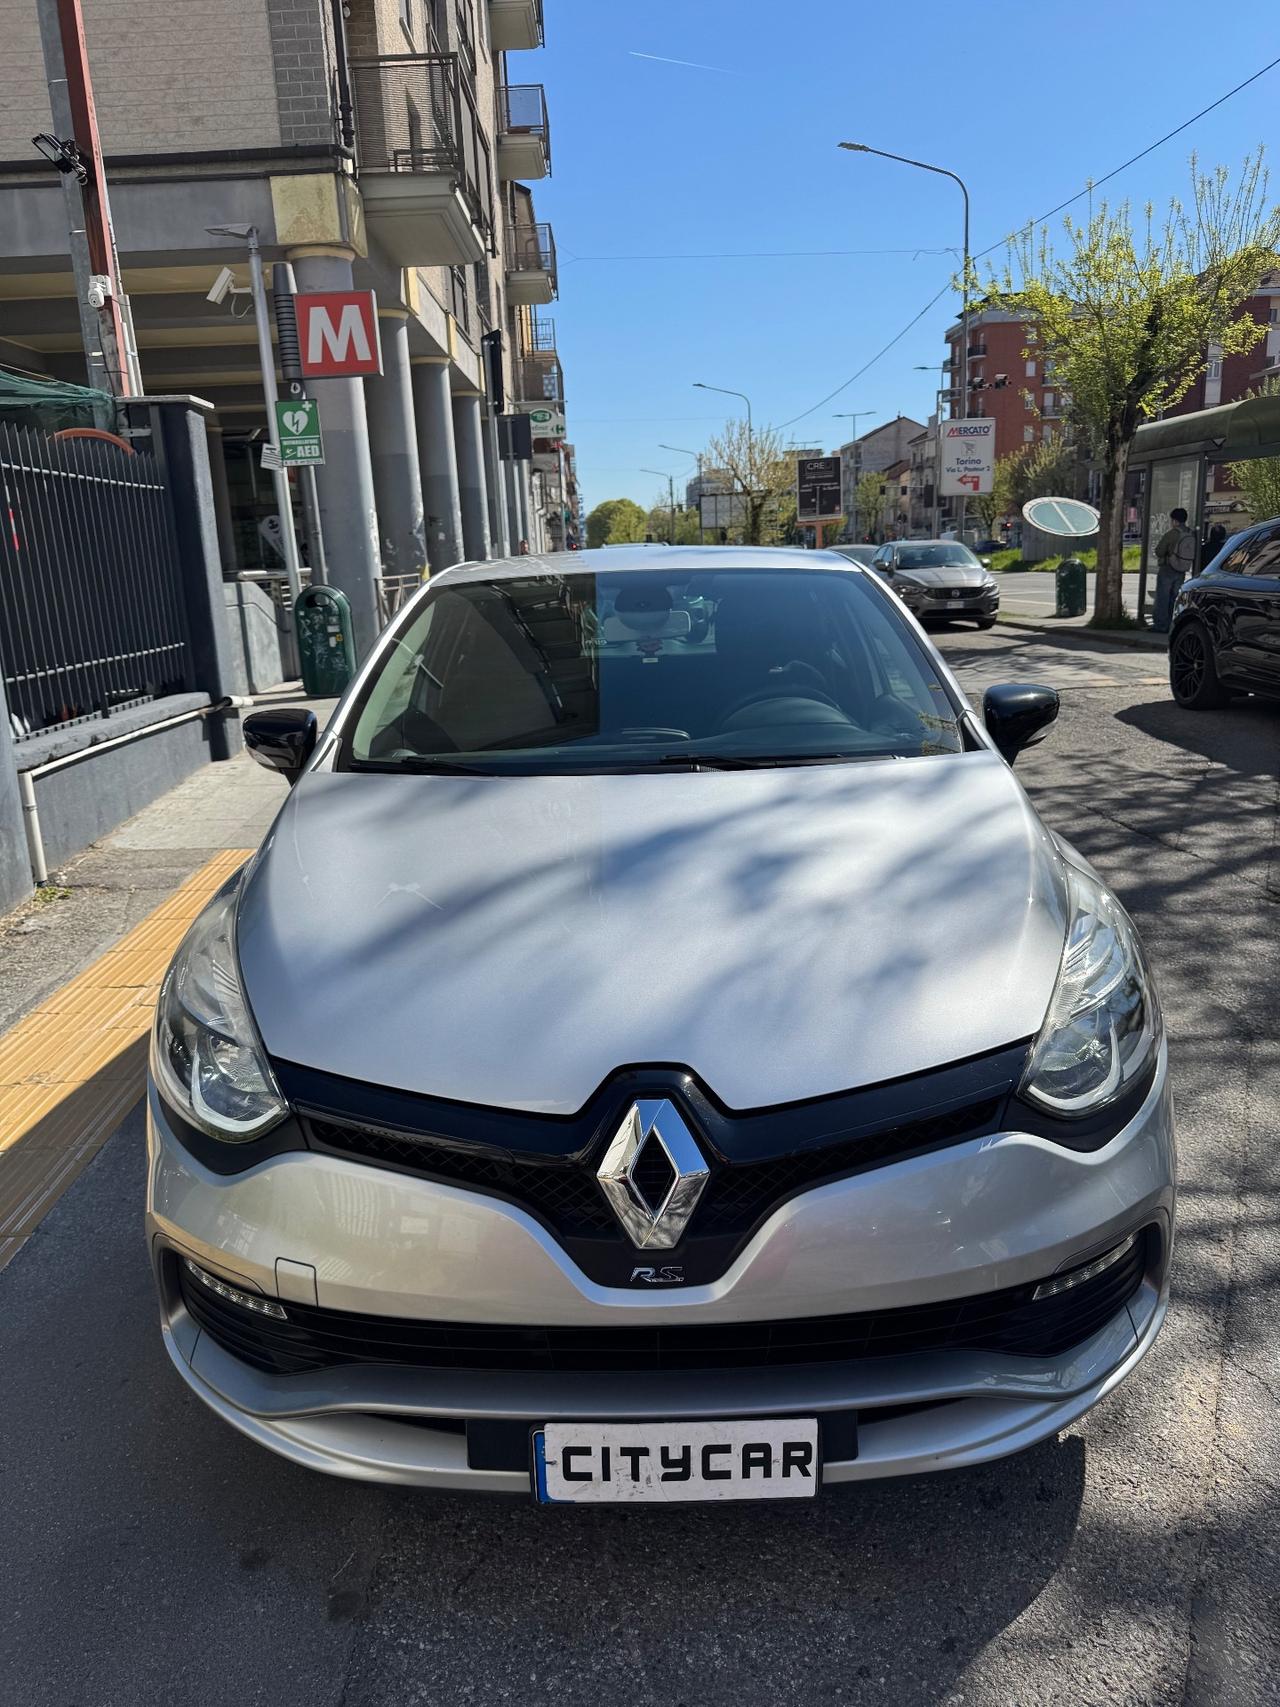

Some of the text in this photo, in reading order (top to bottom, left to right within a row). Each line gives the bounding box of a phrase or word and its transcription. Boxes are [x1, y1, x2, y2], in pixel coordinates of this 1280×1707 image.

[308, 305, 372, 364] M
[947, 426, 991, 437] MERCATO
[297, 445, 320, 457] AED
[956, 457, 982, 465] Torino
[562, 1441, 813, 1482] CITYCAR
